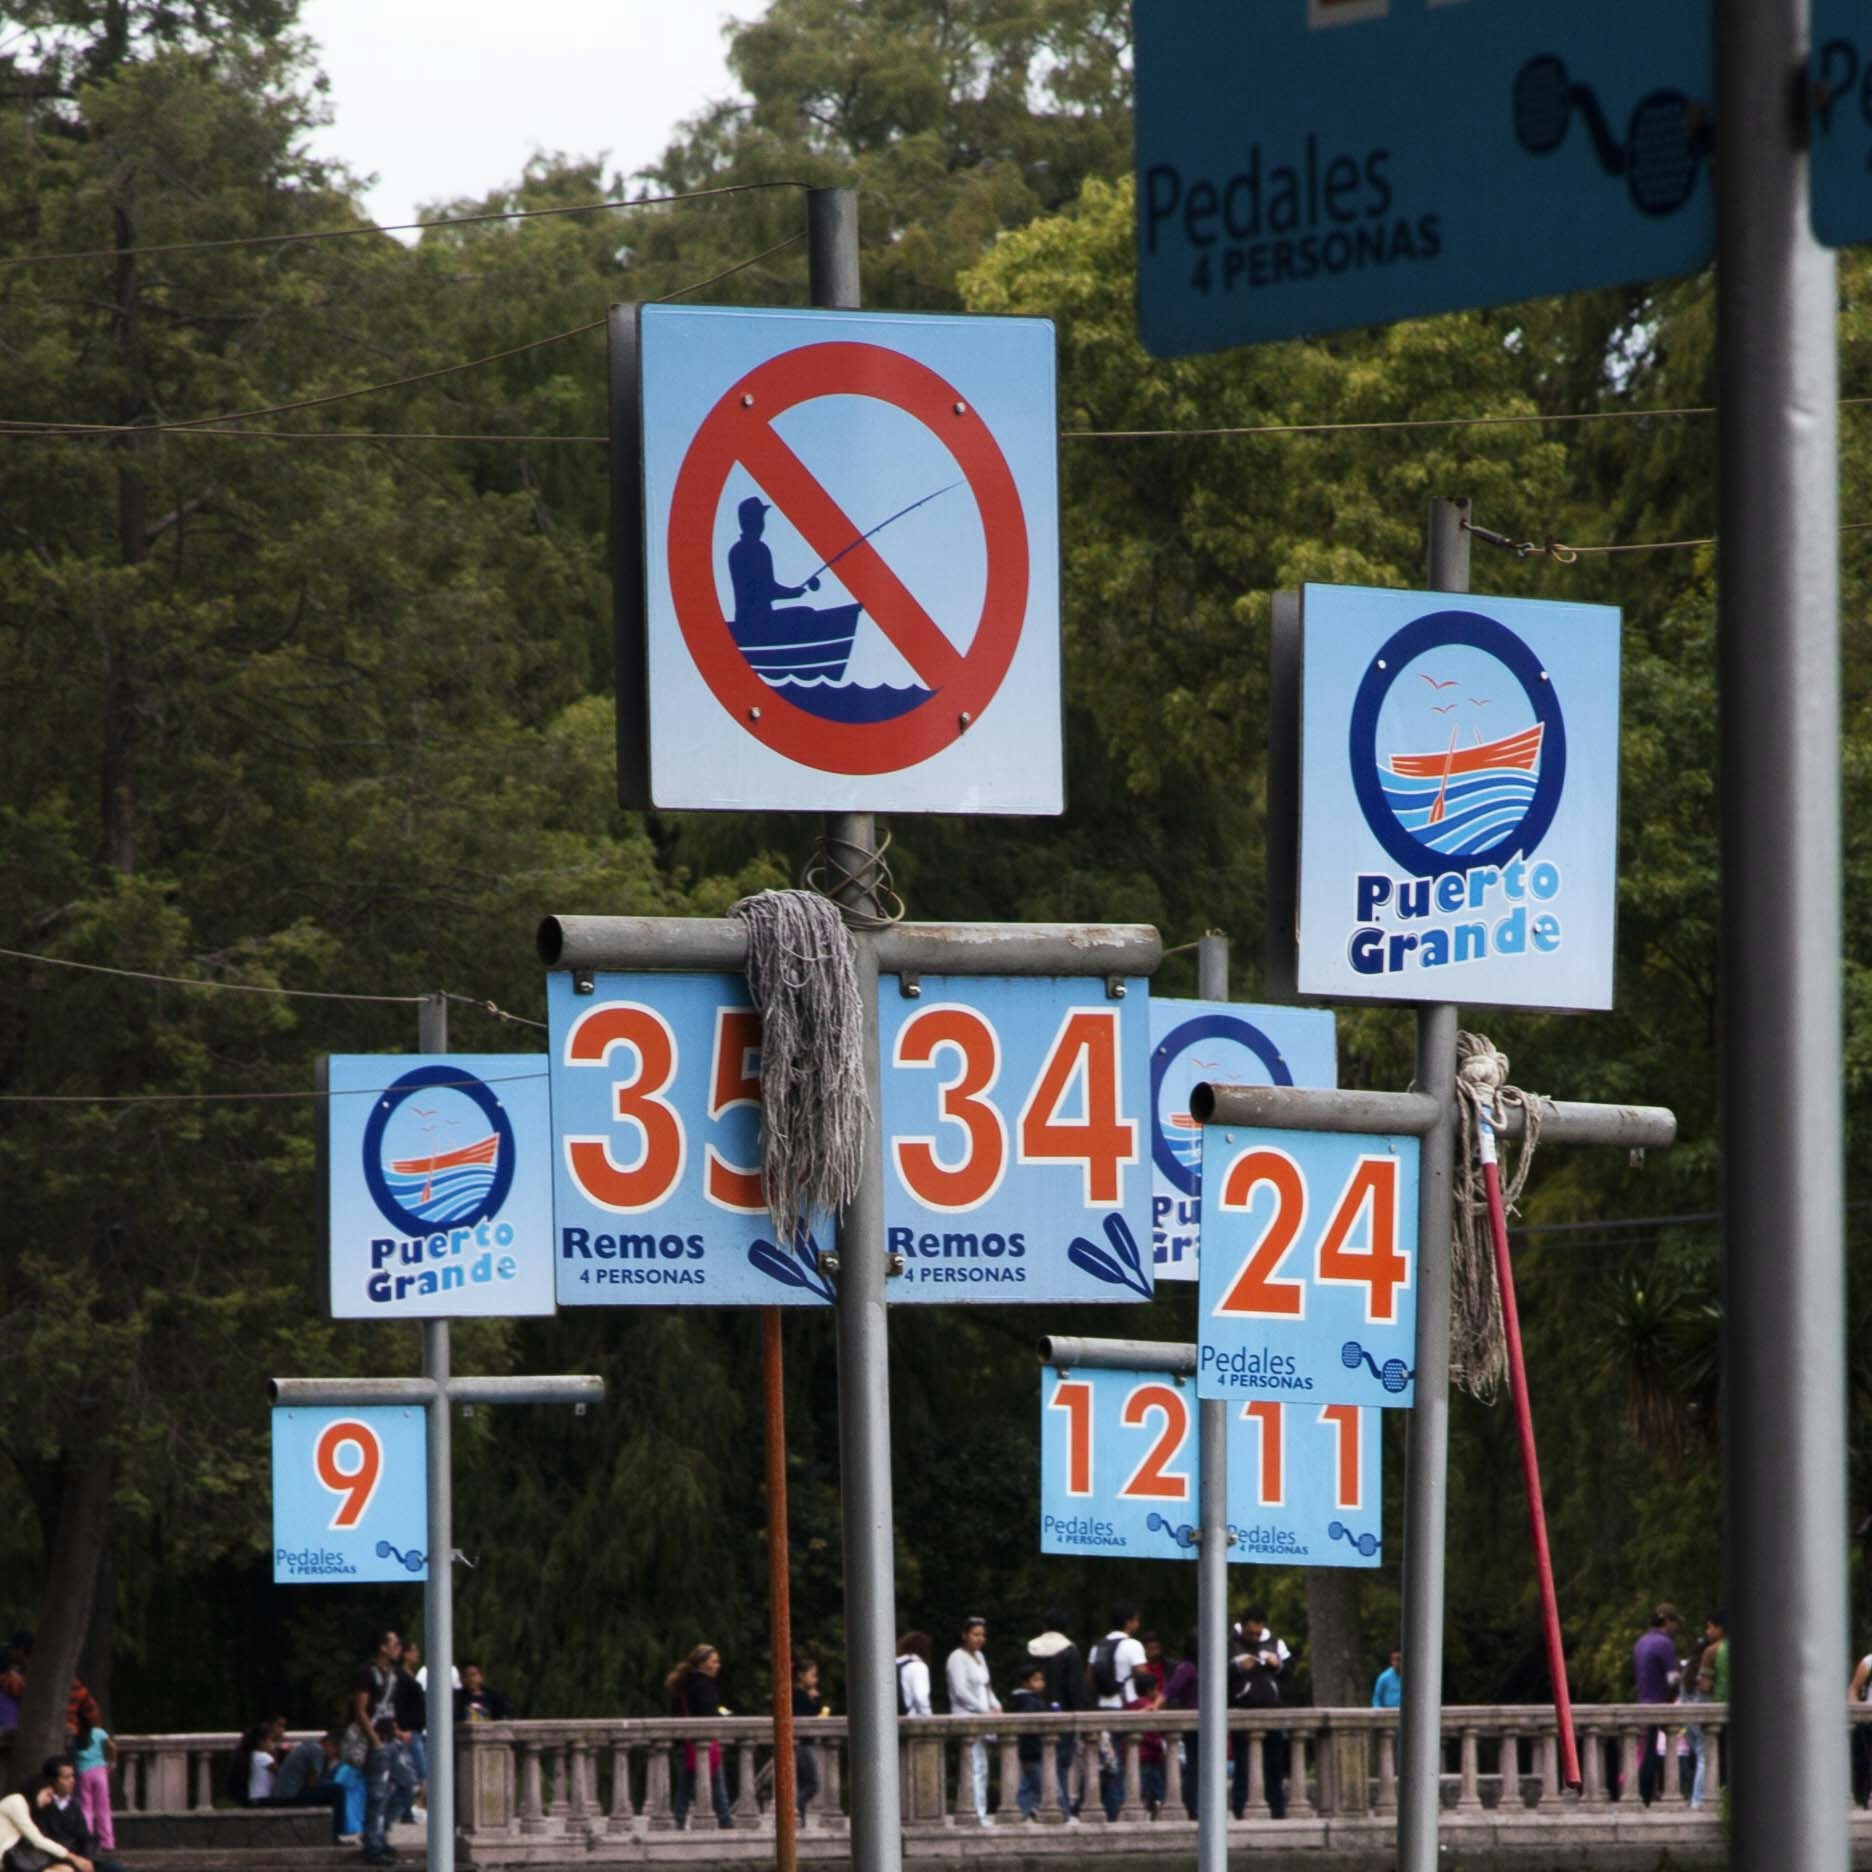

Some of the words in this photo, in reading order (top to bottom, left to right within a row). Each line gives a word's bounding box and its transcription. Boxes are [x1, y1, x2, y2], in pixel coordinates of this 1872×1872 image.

[1145, 131, 1391, 256] Pedales
[1192, 249, 1210, 295] 4
[1223, 215, 1442, 291] PERSONAS
[1355, 850, 1562, 922] Puerto
[1347, 906, 1562, 976] Grande
[892, 1002, 1139, 1214] 34
[370, 1215, 515, 1270] Puerto
[562, 1227, 705, 1259] Remos
[888, 1227, 1026, 1259] Remos
[1212, 1145, 1411, 1325] 24
[365, 1253, 517, 1302] Grande
[580, 1270, 590, 1284] 4
[596, 1269, 705, 1285] PERSONAS
[904, 1268, 915, 1282] 4
[920, 1267, 1026, 1283] PERSONAS
[1201, 1345, 1296, 1375] Pedales
[1217, 1375, 1225, 1386] 4
[1230, 1374, 1313, 1390] PERSONAS
[1047, 1380, 1190, 1501] 12
[1239, 1400, 1362, 1510] 11
[313, 1418, 384, 1530] 9
[1044, 1514, 1113, 1537] Pedales
[1057, 1535, 1064, 1544] 4
[1066, 1535, 1127, 1546] PERSONAS
[277, 1546, 344, 1566] Pedales
[1240, 1544, 1246, 1553] 4
[1248, 1543, 1309, 1555] PERSONAS
[289, 1566, 295, 1575] 4
[297, 1566, 357, 1575] PERSONAS
